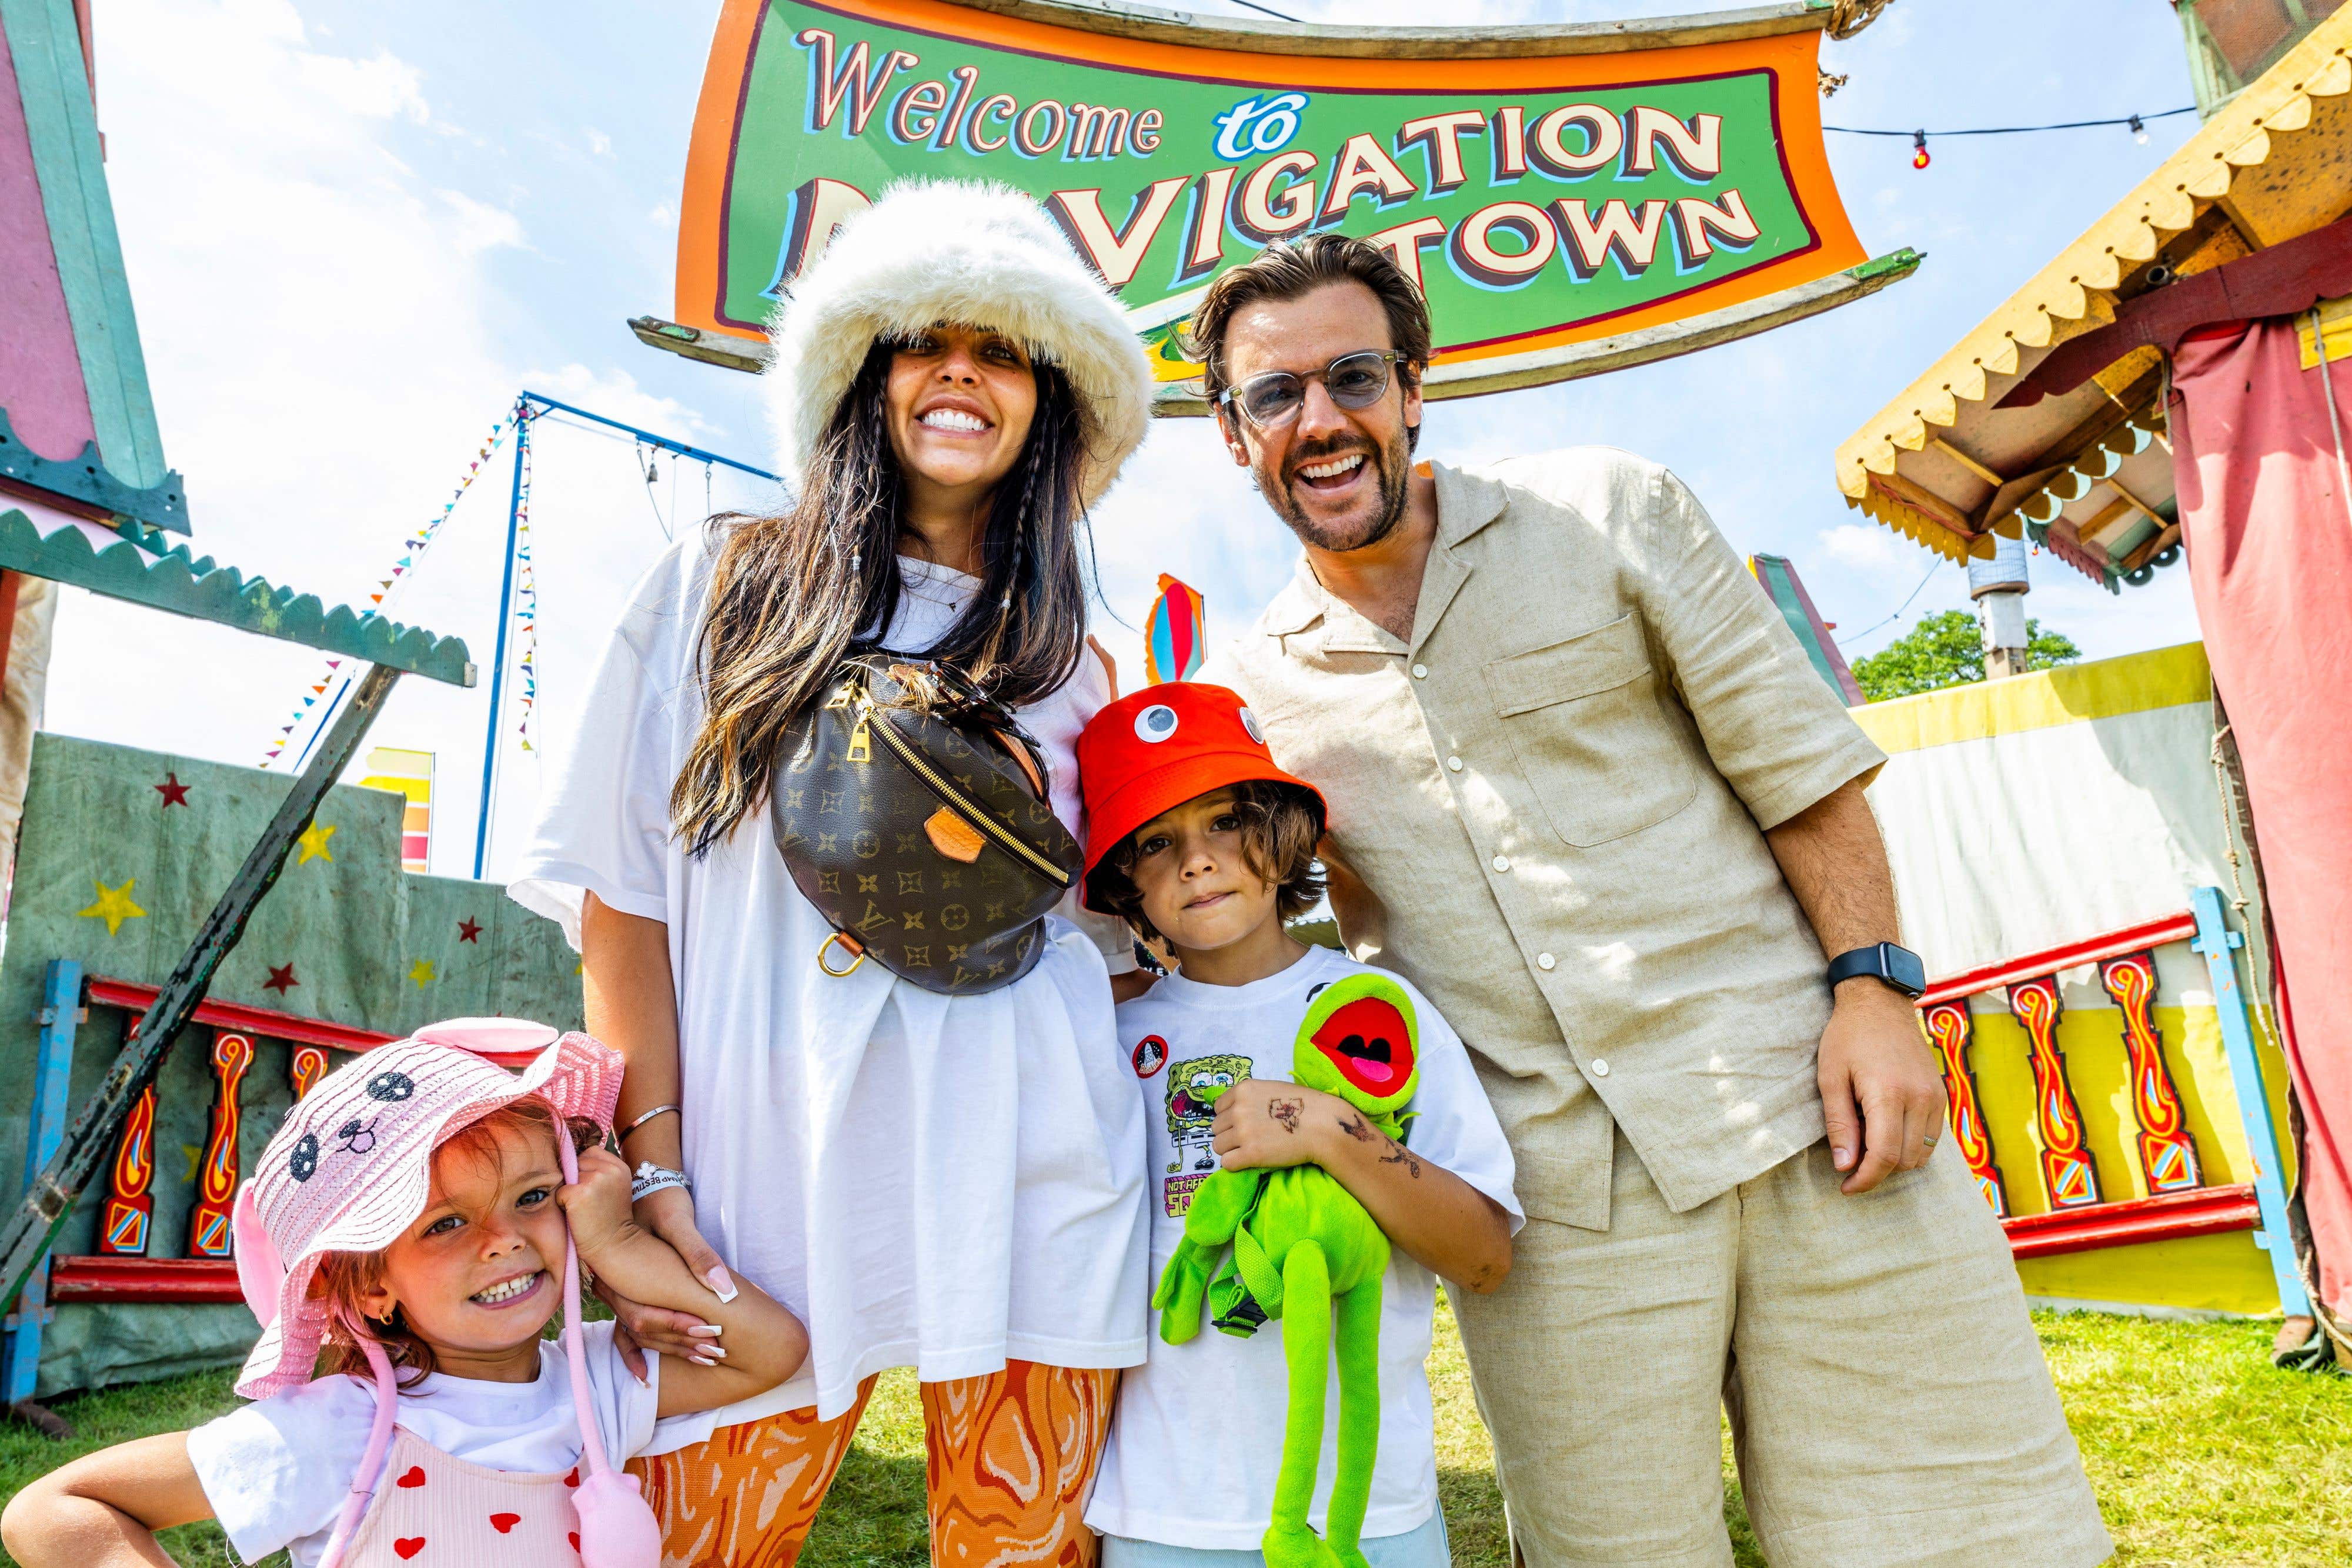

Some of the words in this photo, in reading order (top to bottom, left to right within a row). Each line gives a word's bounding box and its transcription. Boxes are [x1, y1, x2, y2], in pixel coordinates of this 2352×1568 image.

[791, 28, 1164, 162] Welcome
[1212, 91, 1311, 162] to
[761, 102, 1724, 297] VIGATION
[1373, 189, 1762, 301] TOWN
[632, 1176, 661, 1196] BESTIVA
[1165, 1176, 1185, 1193] NOT
[1185, 1175, 1207, 1191] AFR
[1165, 1191, 1195, 1218] SQ
